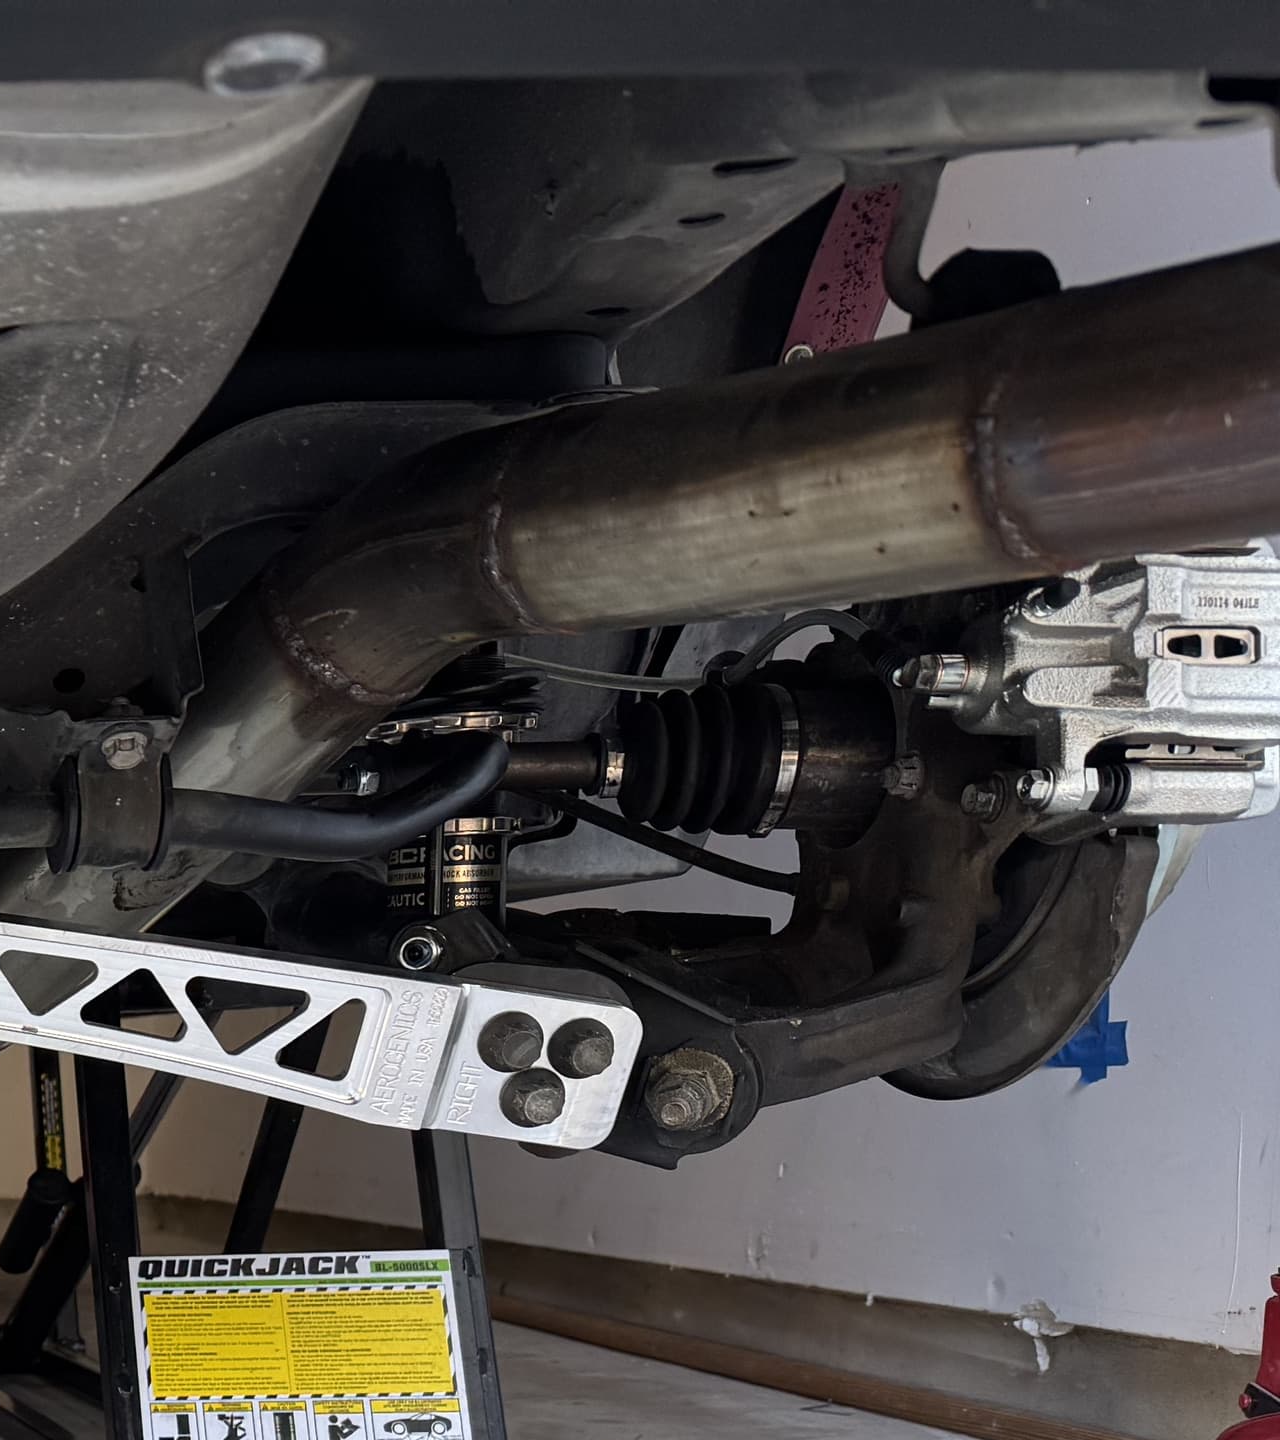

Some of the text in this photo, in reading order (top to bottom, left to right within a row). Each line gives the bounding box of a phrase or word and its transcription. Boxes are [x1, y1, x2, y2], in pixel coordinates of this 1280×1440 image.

[369, 990, 424, 1116] AEROGENICS
[415, 1036, 438, 1063] USA
[407, 1067, 427, 1088] IN
[446, 1060, 484, 1125] RIGHT
[397, 1091, 419, 1127] MADE
[138, 1255, 361, 1279] QUICKJACK
